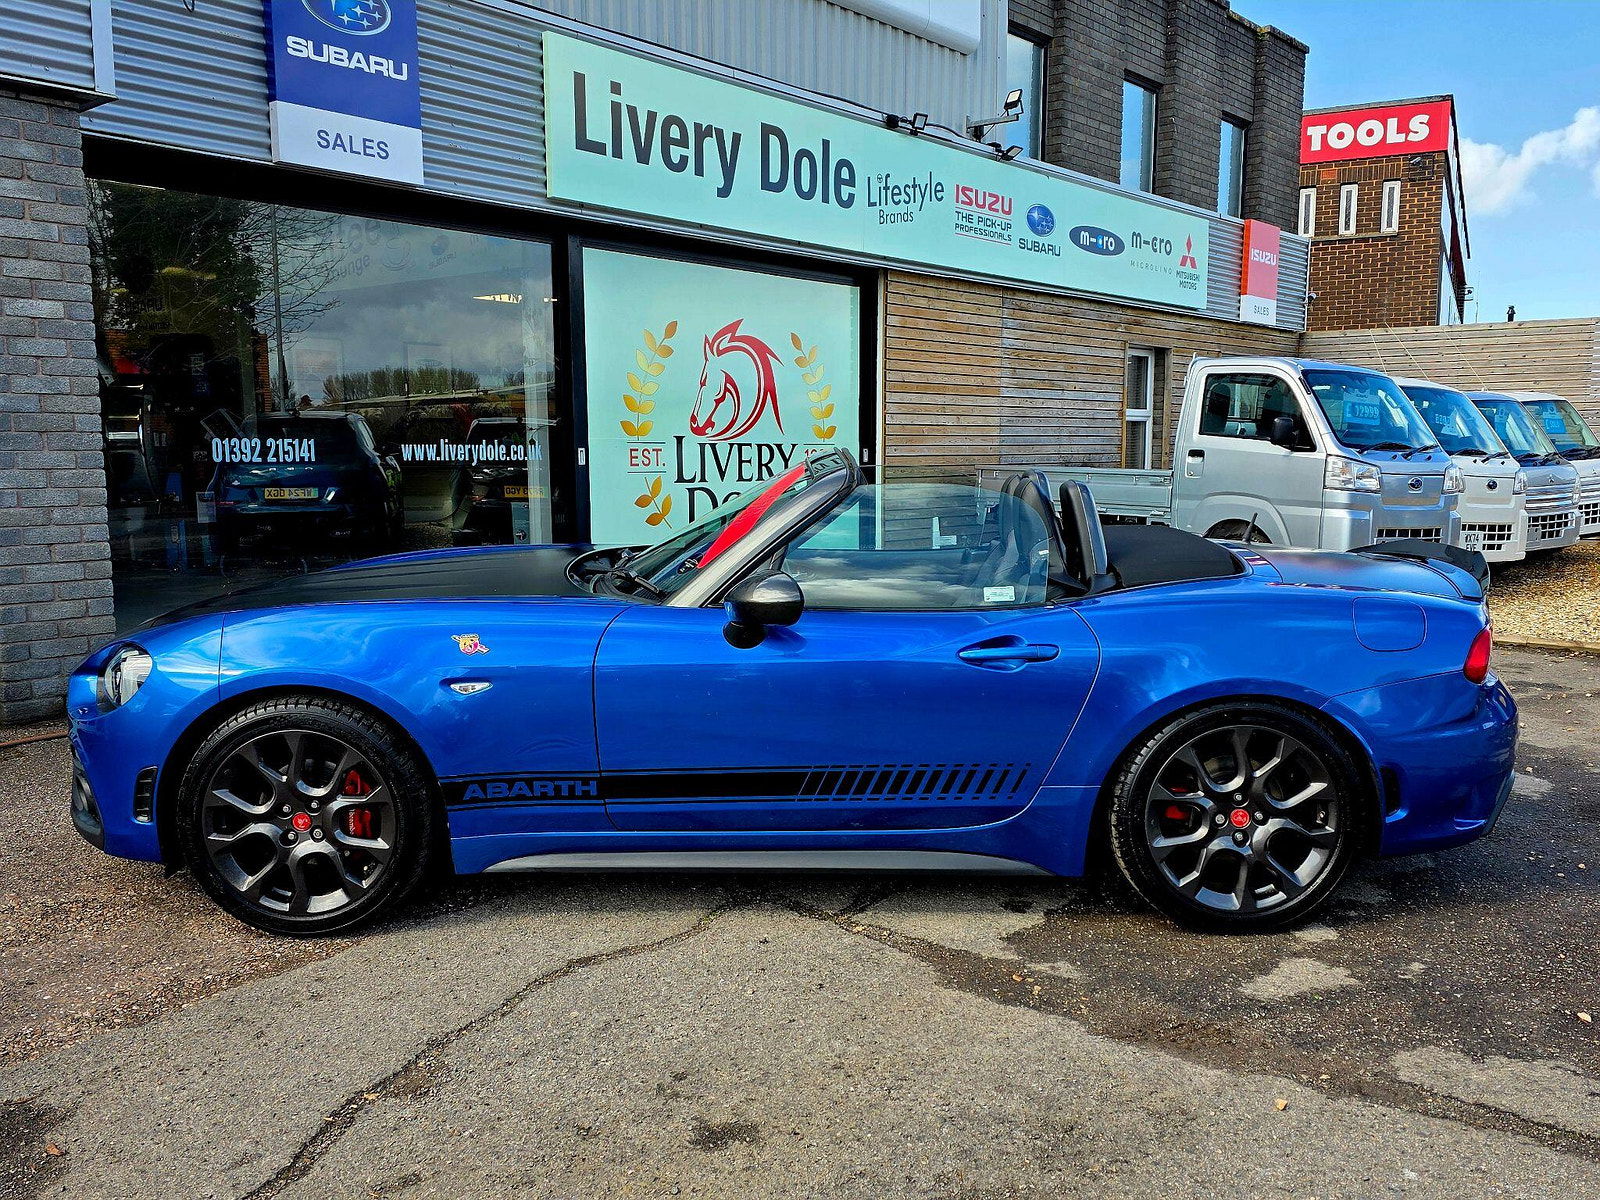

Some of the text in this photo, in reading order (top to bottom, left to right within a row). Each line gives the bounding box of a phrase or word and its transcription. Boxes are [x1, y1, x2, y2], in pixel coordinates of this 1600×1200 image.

[286, 35, 408, 81] SUBARU
[572, 70, 856, 209] Livery Dole
[1306, 114, 1430, 151] TOOLS
[316, 129, 390, 160] SALES
[867, 171, 945, 212] Lifestyle
[955, 183, 1013, 216] ISUZU
[878, 208, 914, 226] Brands
[955, 210, 1012, 232] THE PICK-UP
[954, 222, 1012, 242] PROFESSIONALS
[1018, 237, 1061, 257] SUBARU
[1250, 247, 1277, 266] ISUZU
[1130, 259, 1172, 275] MICROLINO
[1175, 269, 1200, 282] MITSUBISHI
[1179, 279, 1197, 291] MOTORS
[1253, 304, 1270, 317] SALES
[211, 437, 317, 463] 01392 215141
[401, 438, 544, 467] www.liverydole.co.uk
[629, 448, 666, 467] EST.
[463, 780, 599, 801] ABARTH
